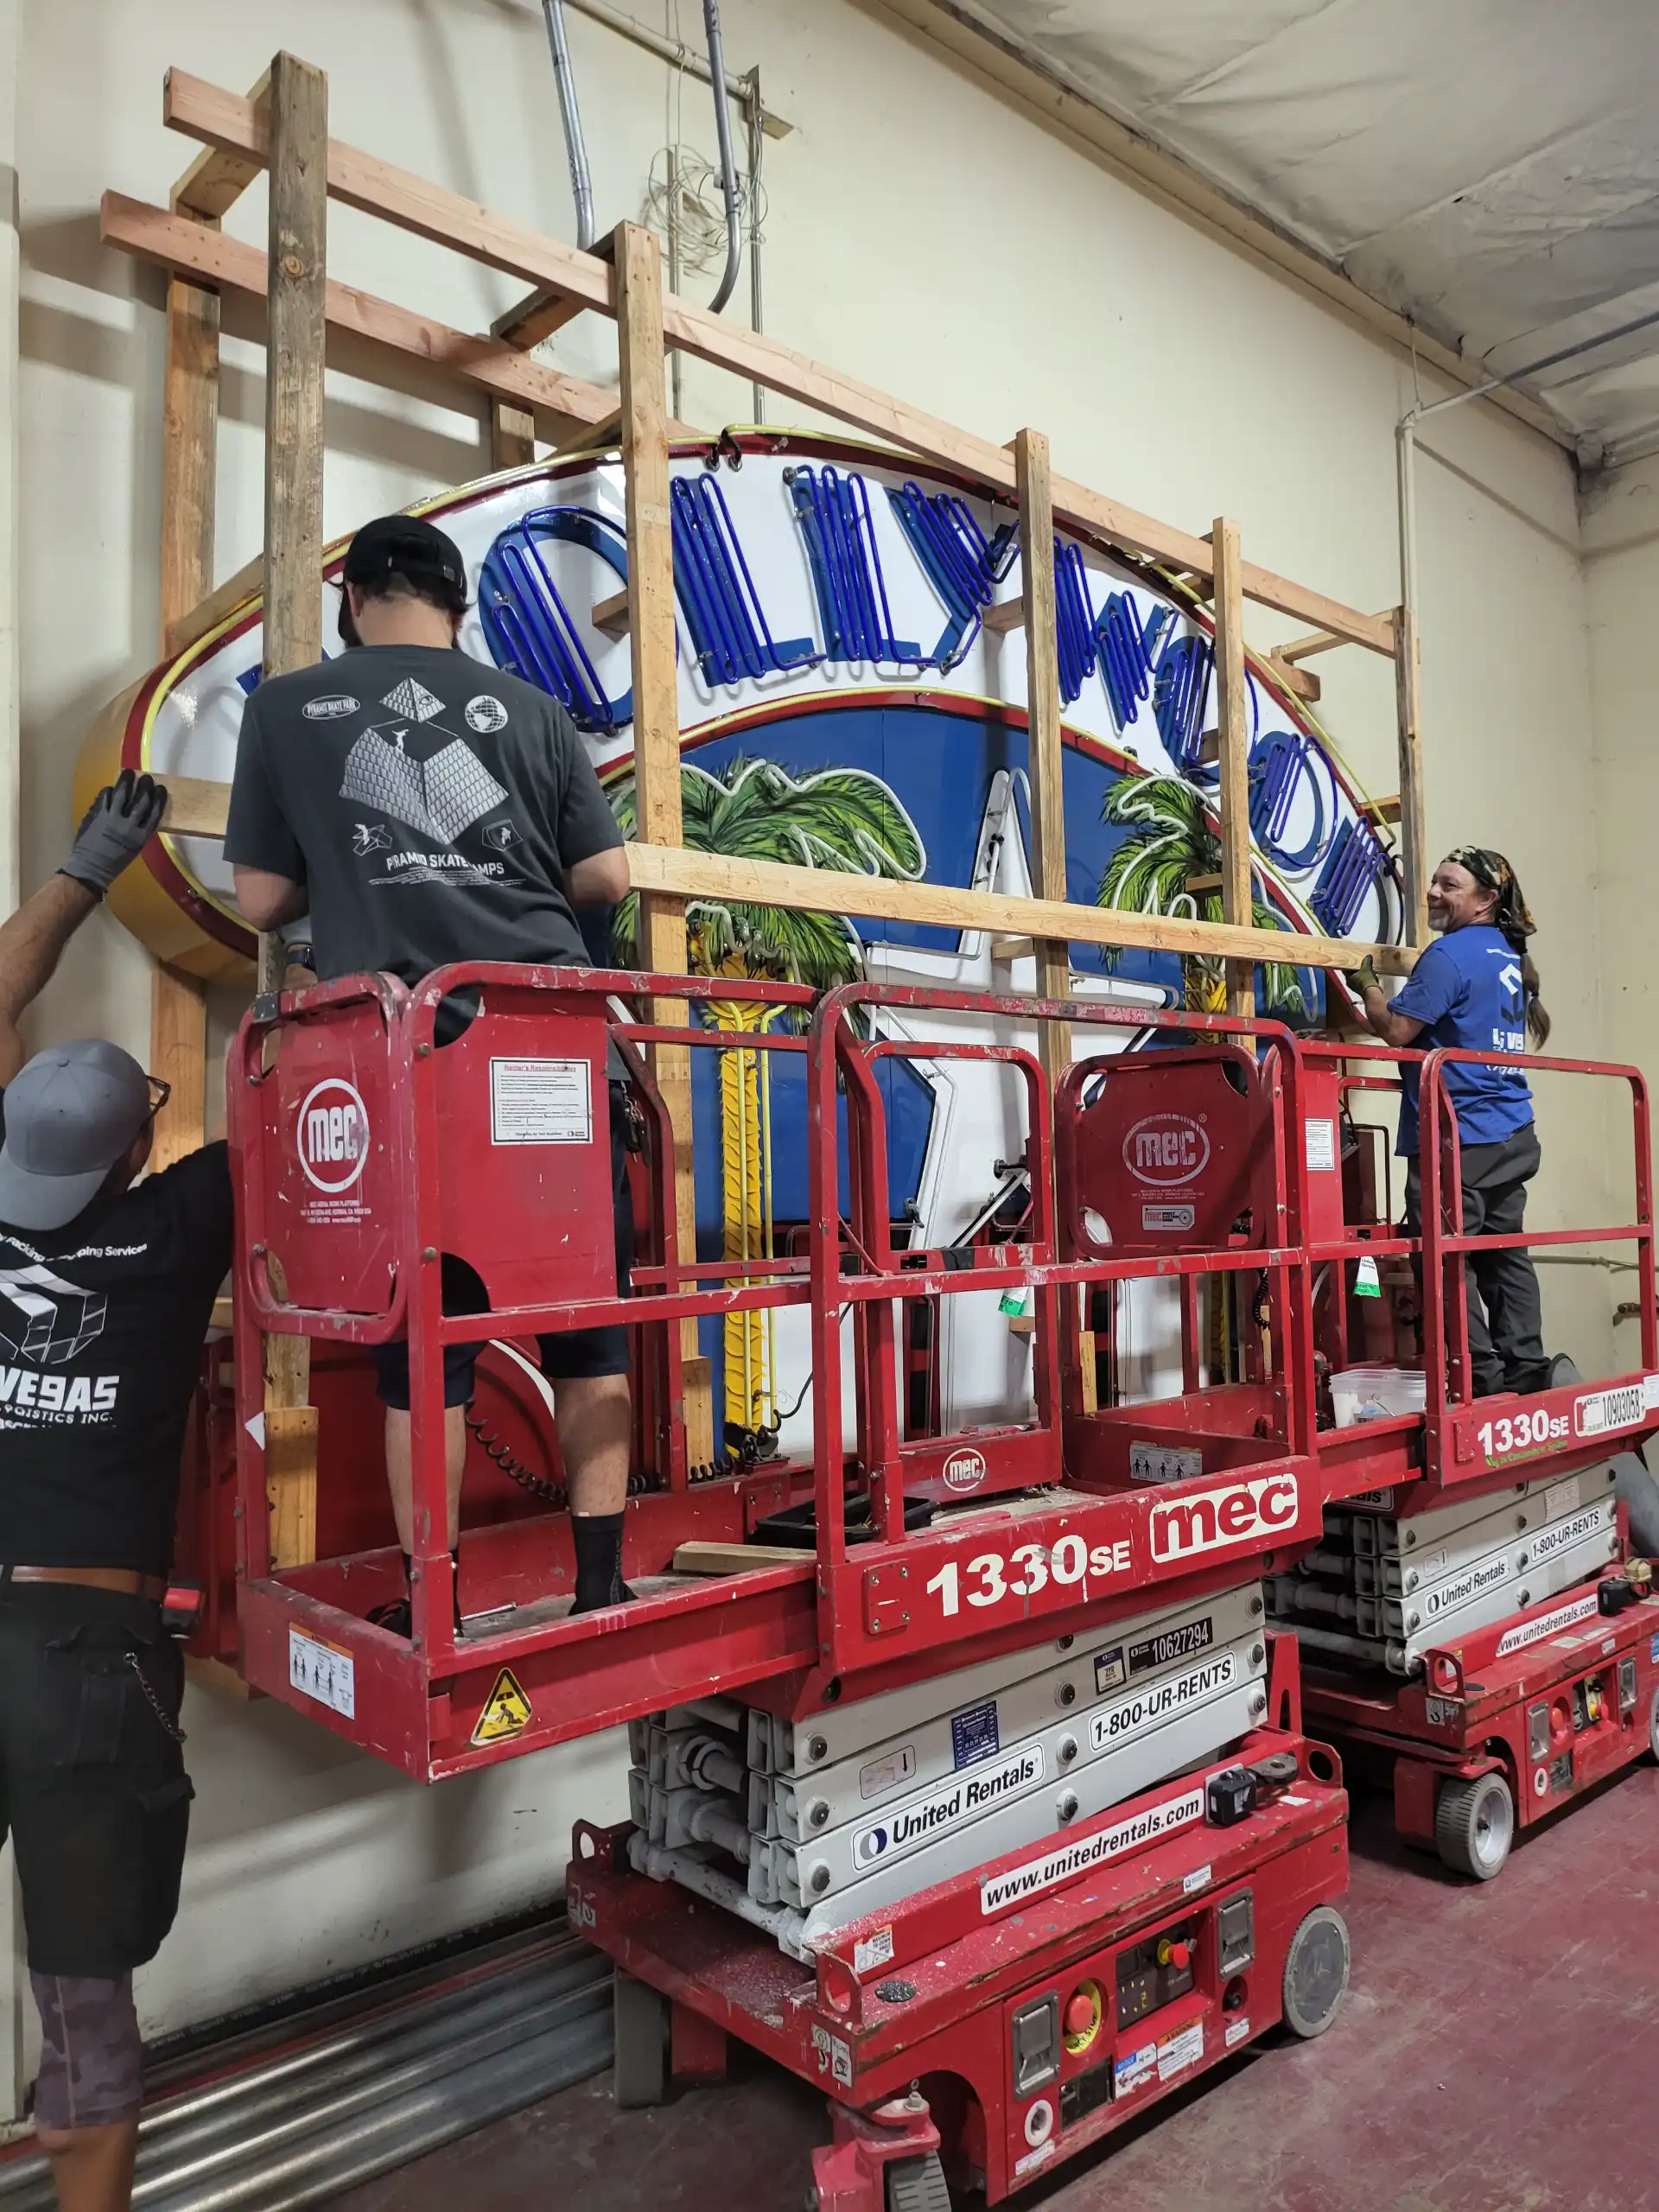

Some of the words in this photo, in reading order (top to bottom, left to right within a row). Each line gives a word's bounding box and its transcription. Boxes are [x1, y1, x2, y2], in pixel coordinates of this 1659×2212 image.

[235, 465, 1404, 949] OLLYWOOD
[429, 854, 468, 868] SKATE
[467, 861, 505, 876] AMPS
[308, 1104, 358, 1163] mec
[1135, 1130, 1196, 1167] mec
[105, 1243, 148, 1257] Services
[80, 1412, 113, 1425] INC.
[1478, 1409, 1569, 1456] 1330SE
[949, 1458, 981, 1483] mec
[1153, 1482, 1297, 1556] mec
[1533, 1510, 1599, 1558] 1-800-UR-RENTS
[926, 1535, 1132, 1618] 1330SE
[1441, 1574, 1472, 1606] United
[1473, 1560, 1505, 1589] Rentals
[1152, 1620, 1209, 1664] 10627294
[1095, 1659, 1231, 1743] 1-800-UR-RENTS
[893, 1789, 961, 1845] United
[966, 1758, 1034, 1808] Rentals
[986, 1798, 1199, 1907] www.unitedrentals.com
